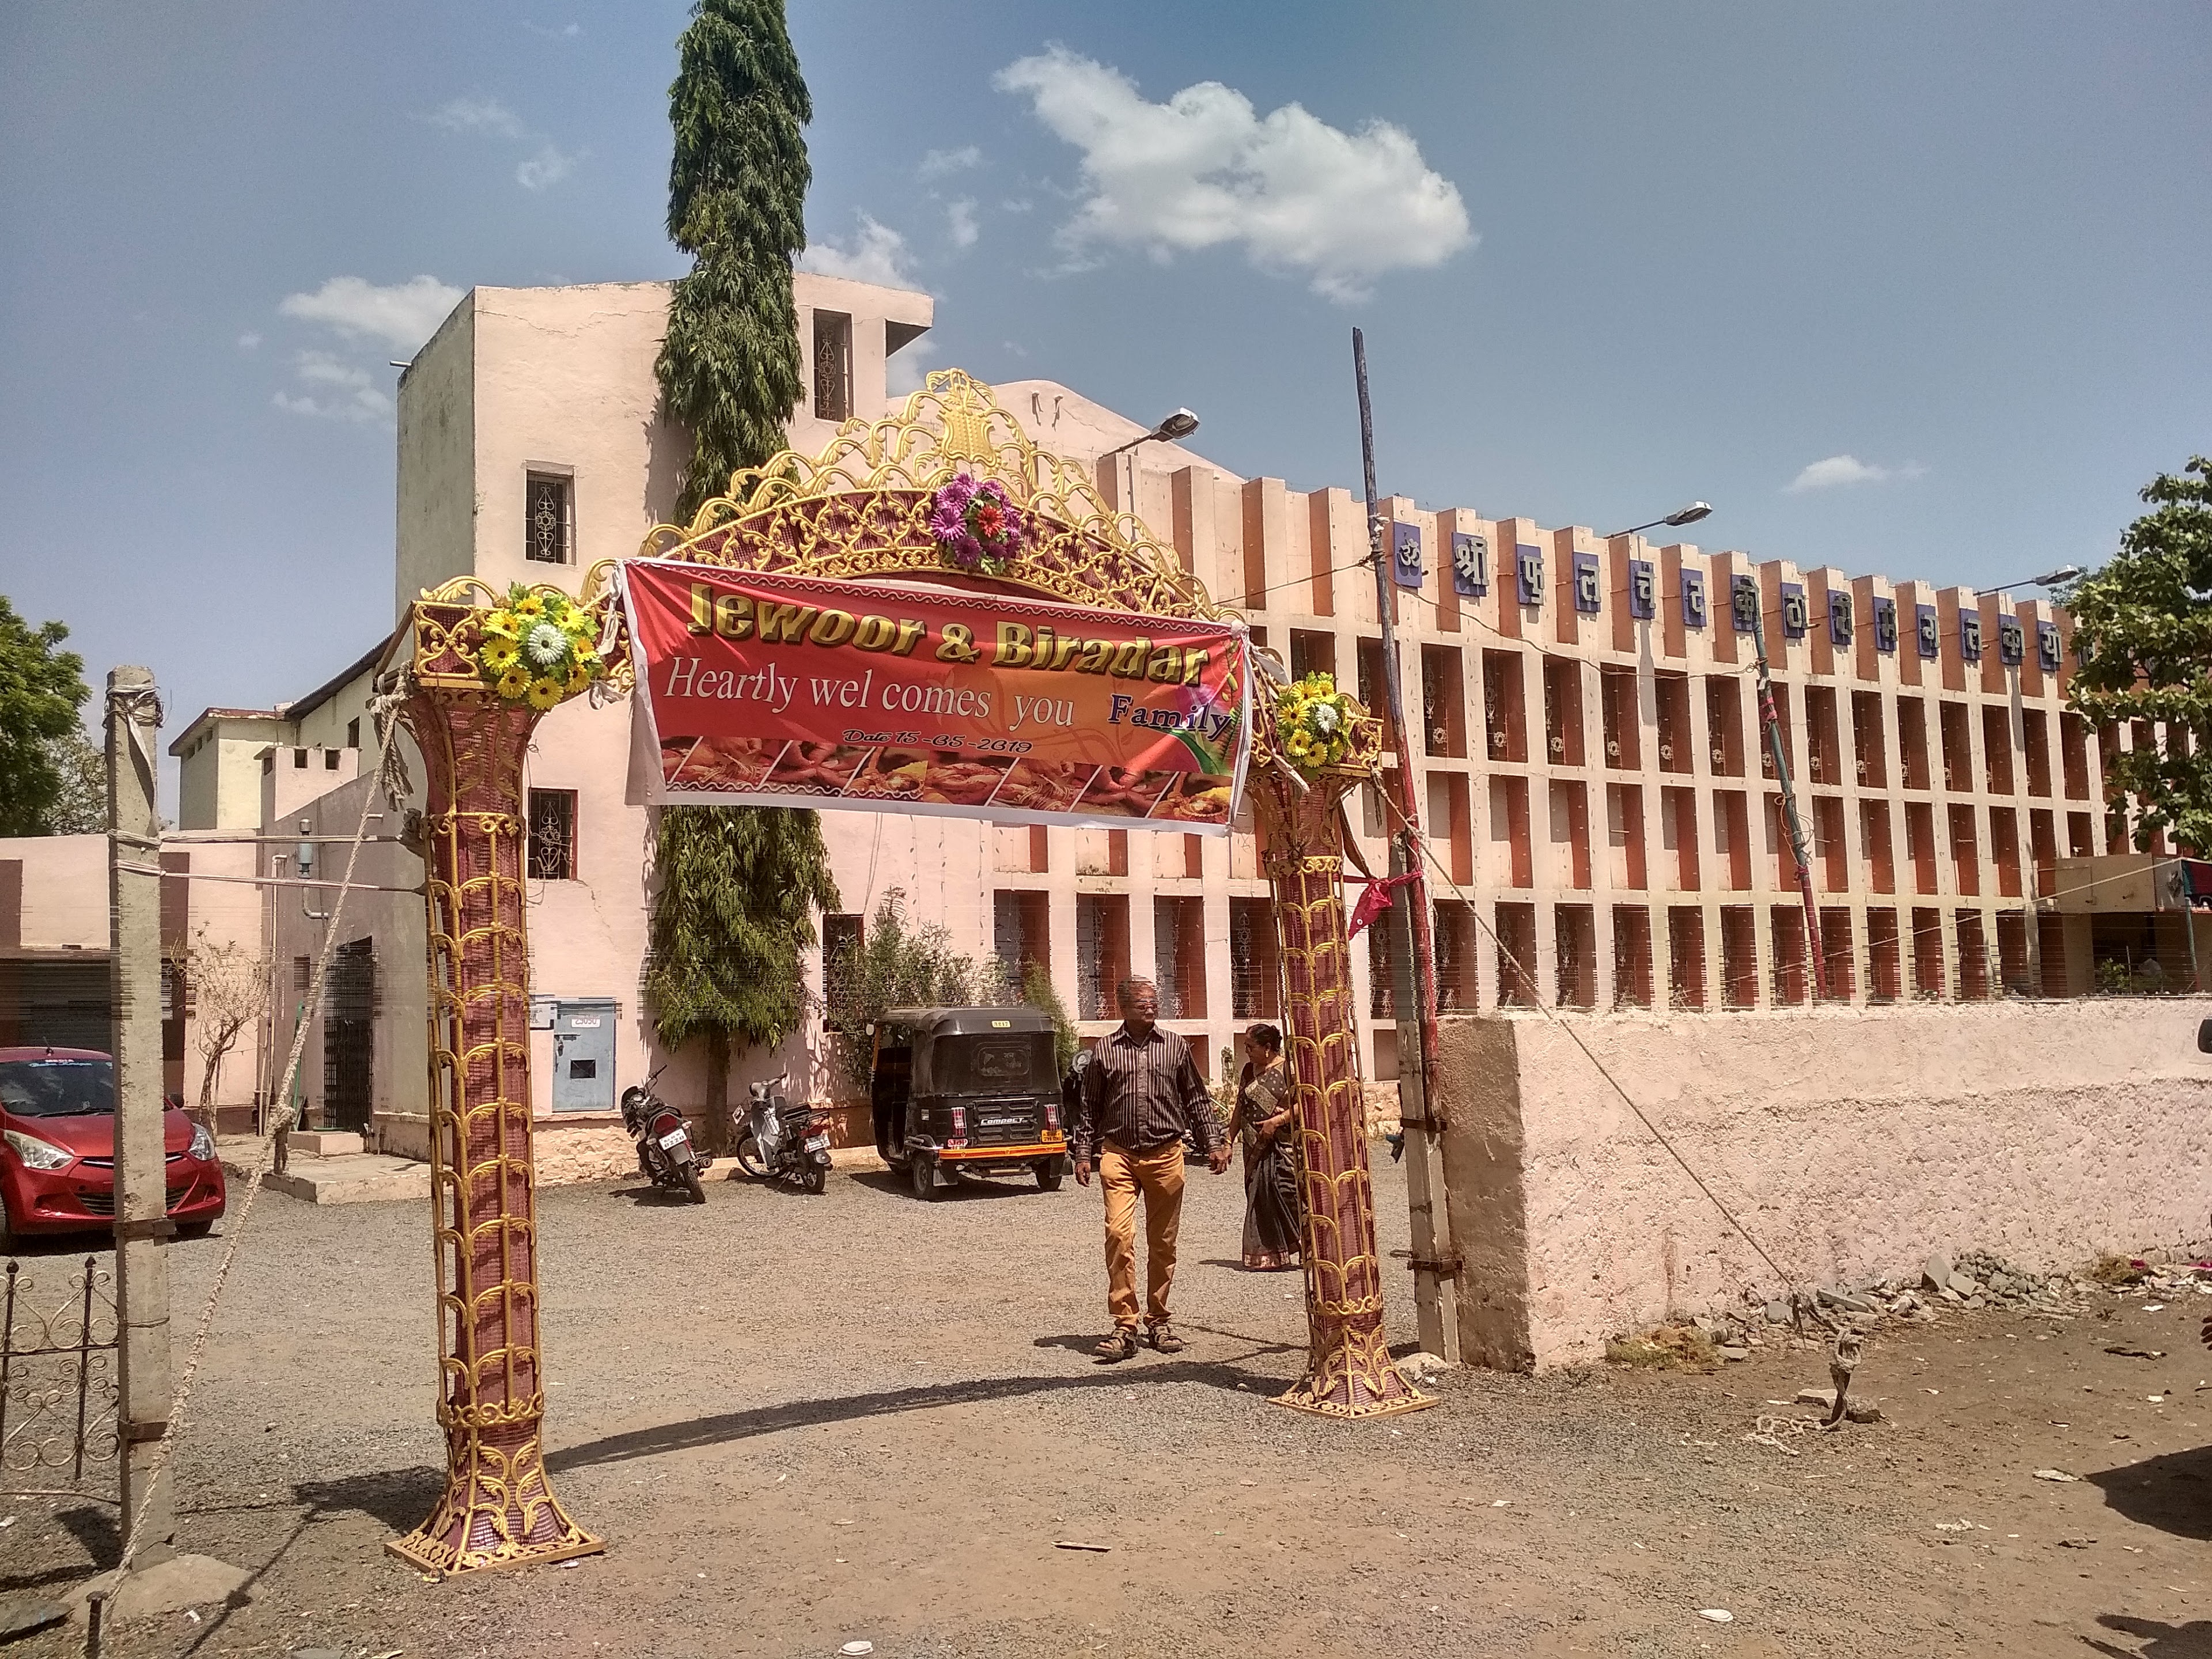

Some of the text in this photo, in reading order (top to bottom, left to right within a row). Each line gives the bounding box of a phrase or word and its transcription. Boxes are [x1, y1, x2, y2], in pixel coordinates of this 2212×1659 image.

[687, 582, 1209, 686] Jewoor & Biradar
[663, 657, 798, 714] Heartly
[881, 682, 992, 718] comes
[1009, 694, 1074, 732] you
[1107, 693, 1232, 741] Family
[843, 729, 893, 743] Date
